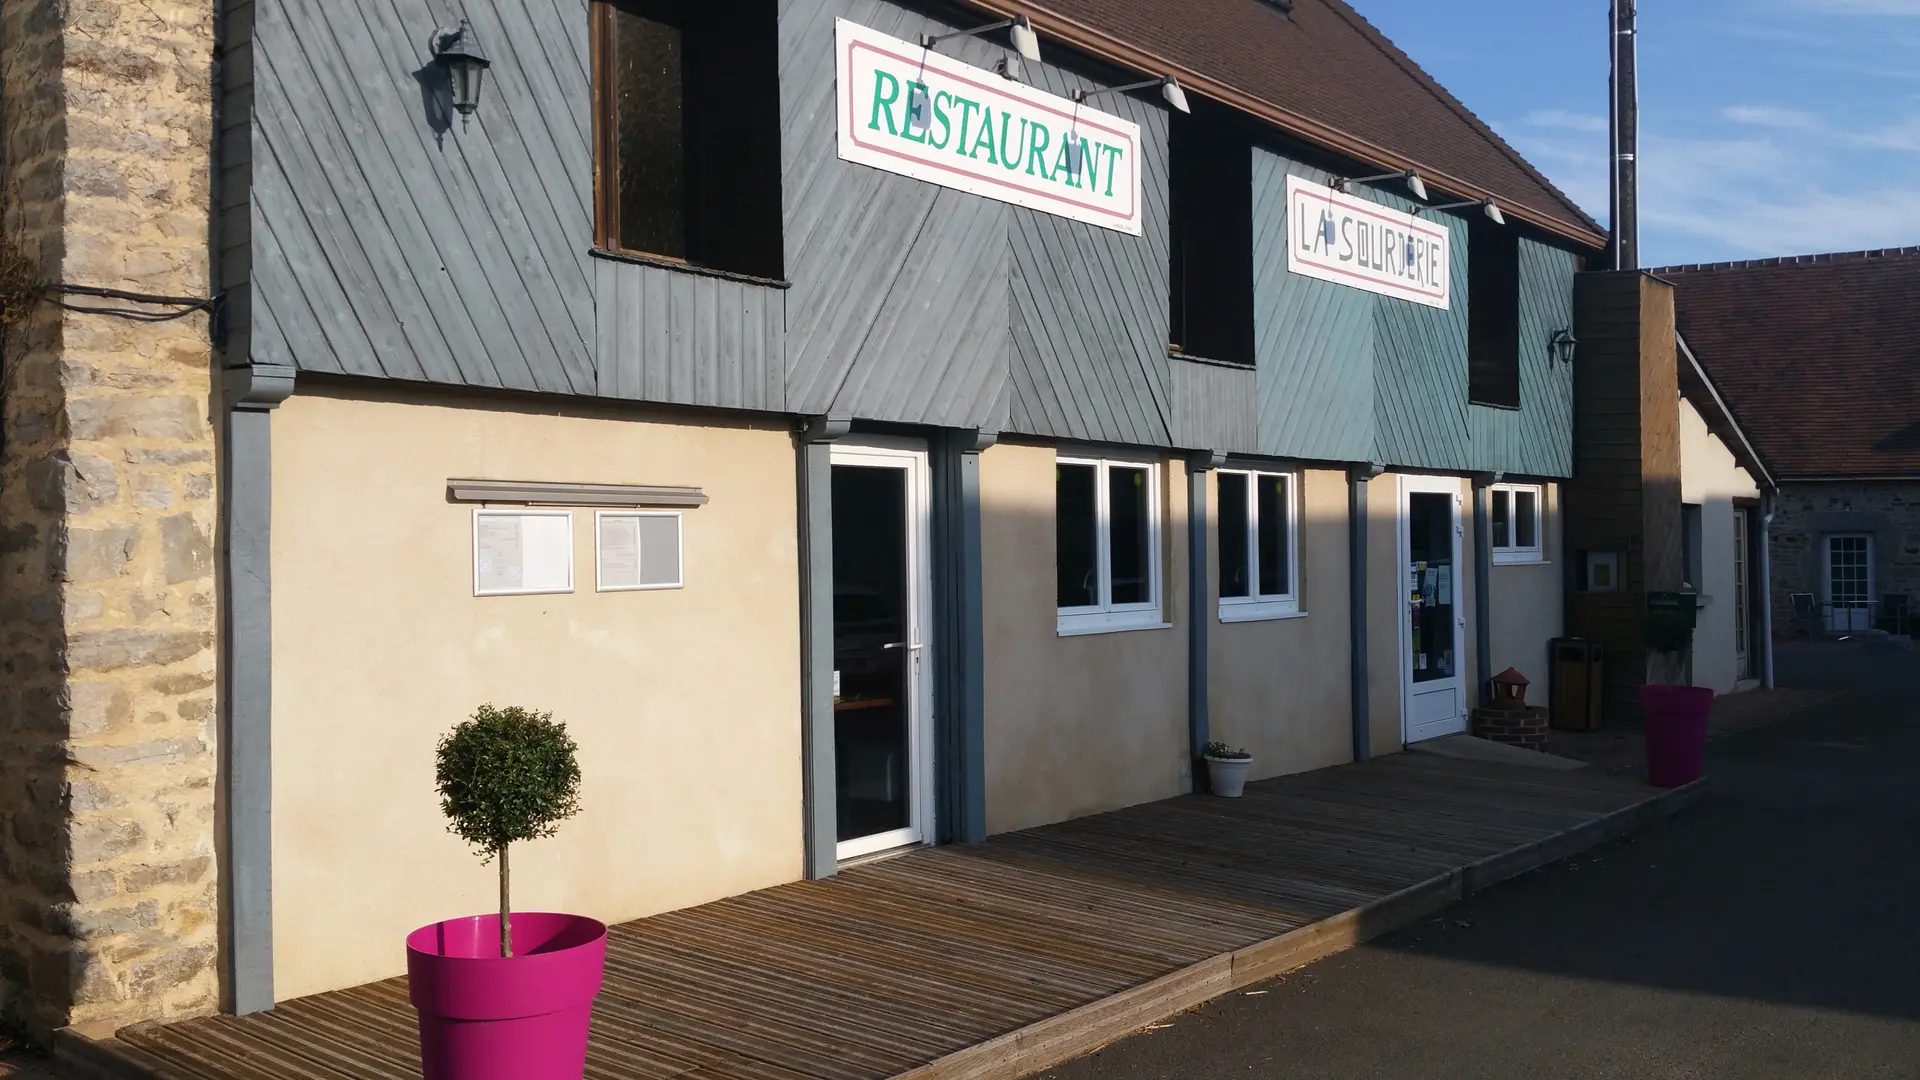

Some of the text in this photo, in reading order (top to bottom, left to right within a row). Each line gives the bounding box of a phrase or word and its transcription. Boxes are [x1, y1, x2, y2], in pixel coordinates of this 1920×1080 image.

[868, 69, 1123, 197] RESTAURANT
[1301, 202, 1440, 288] LA SOURDERIE
